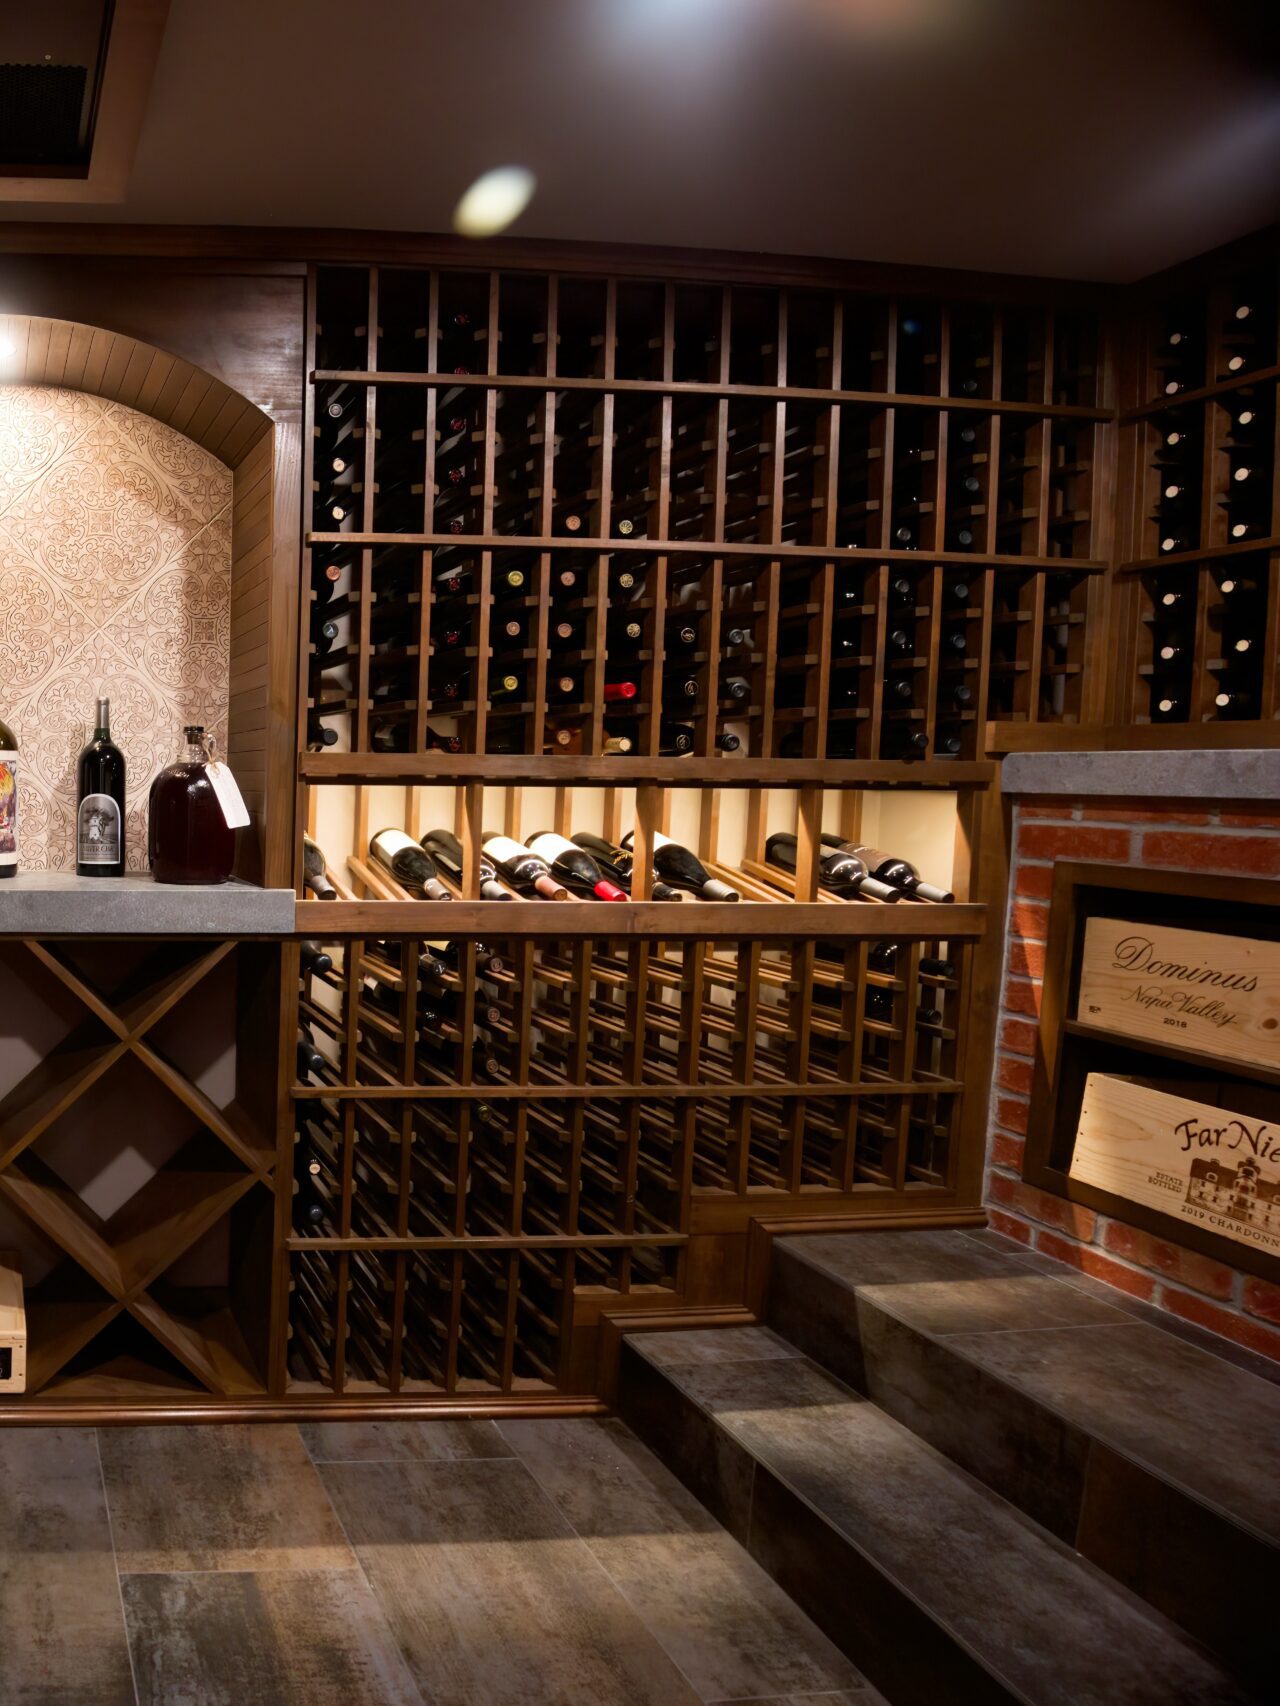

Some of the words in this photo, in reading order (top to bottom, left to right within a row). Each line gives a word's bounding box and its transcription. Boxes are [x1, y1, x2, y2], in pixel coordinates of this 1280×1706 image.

[1111, 936, 1258, 992] Dominus
[1121, 985, 1173, 1009] Napa
[1171, 991, 1237, 1028] Valley
[1174, 1118, 1227, 1151] Far
[1148, 1176, 1182, 1193] BOTTLED
[1156, 1172, 1183, 1187] ESTATE
[1181, 1204, 1205, 1219] 2019
